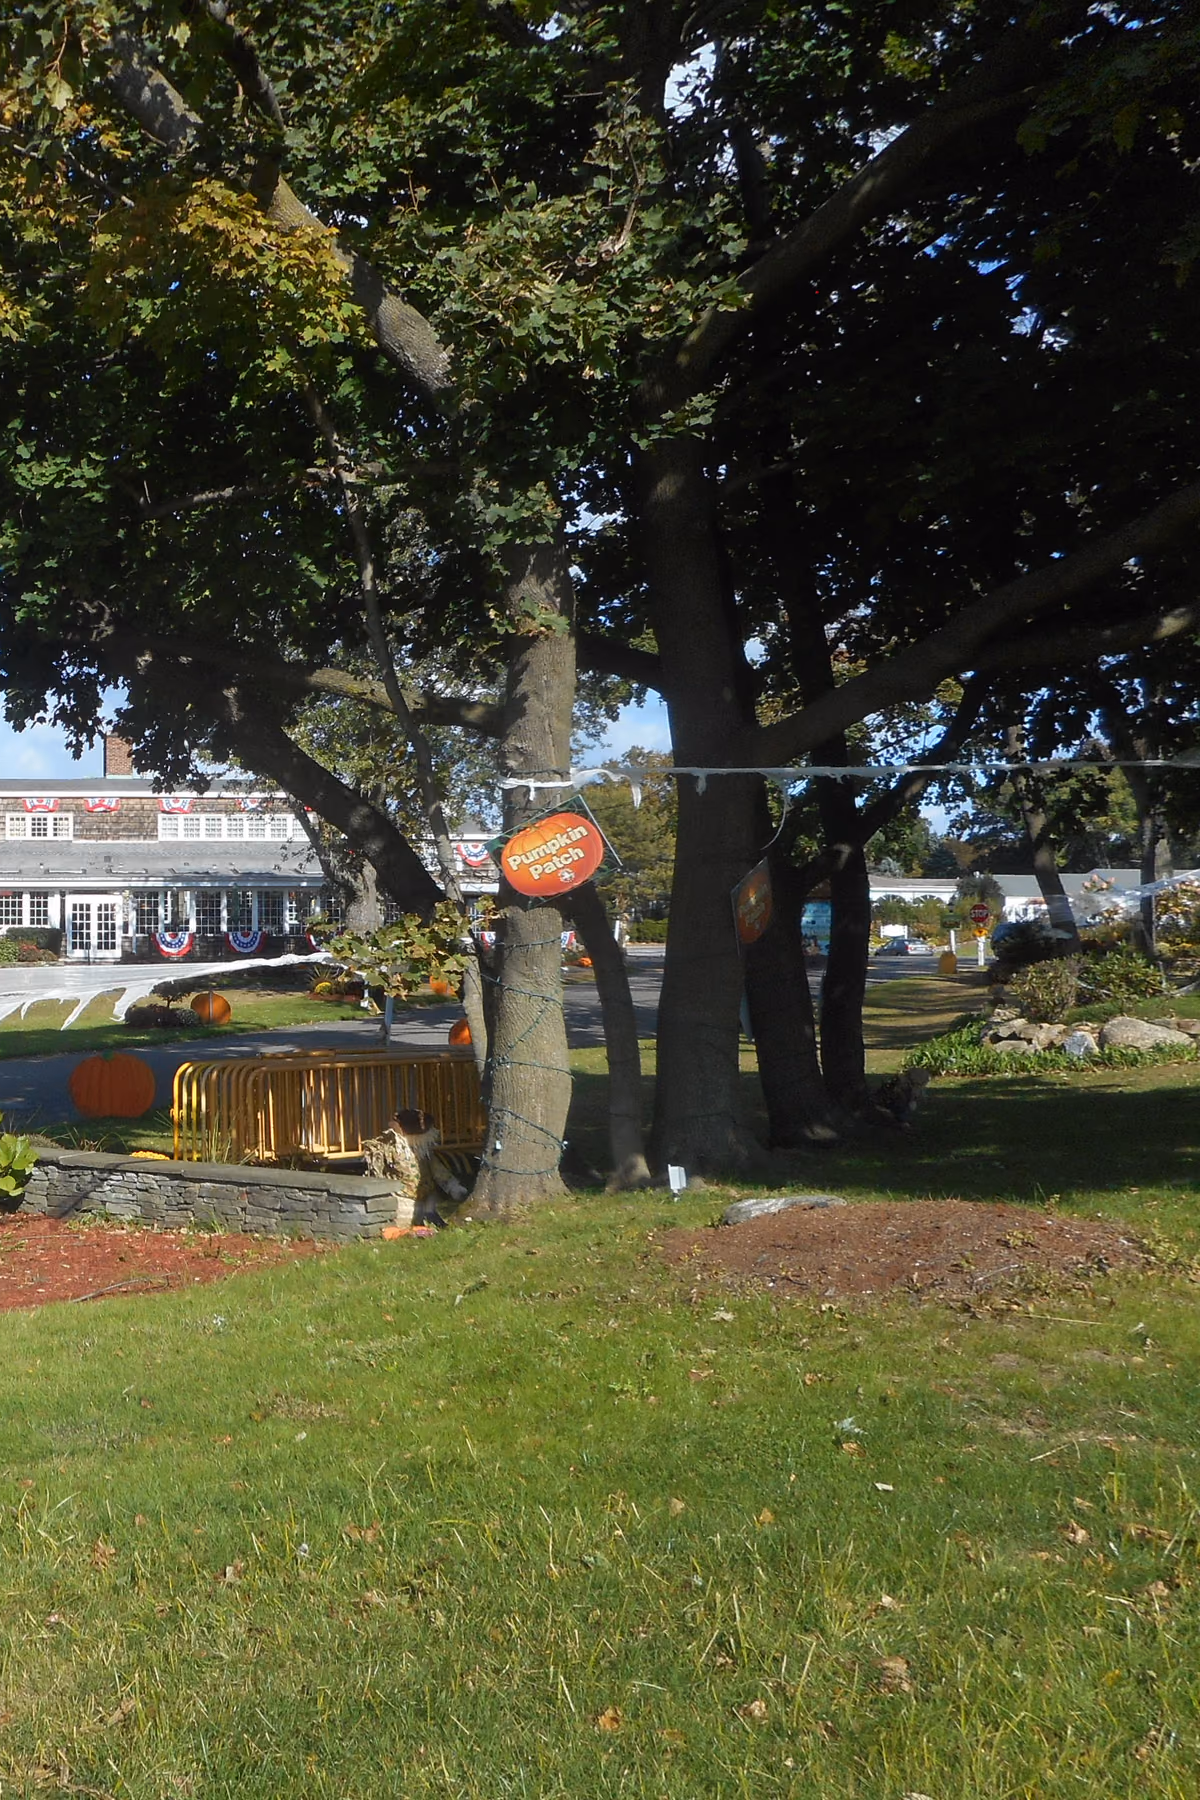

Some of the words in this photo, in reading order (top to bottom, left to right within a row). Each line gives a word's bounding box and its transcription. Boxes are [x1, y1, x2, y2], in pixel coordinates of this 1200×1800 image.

[507, 825, 589, 871] Pumpkin
[529, 847, 585, 880] Patch
[971, 909, 989, 918] STOP
